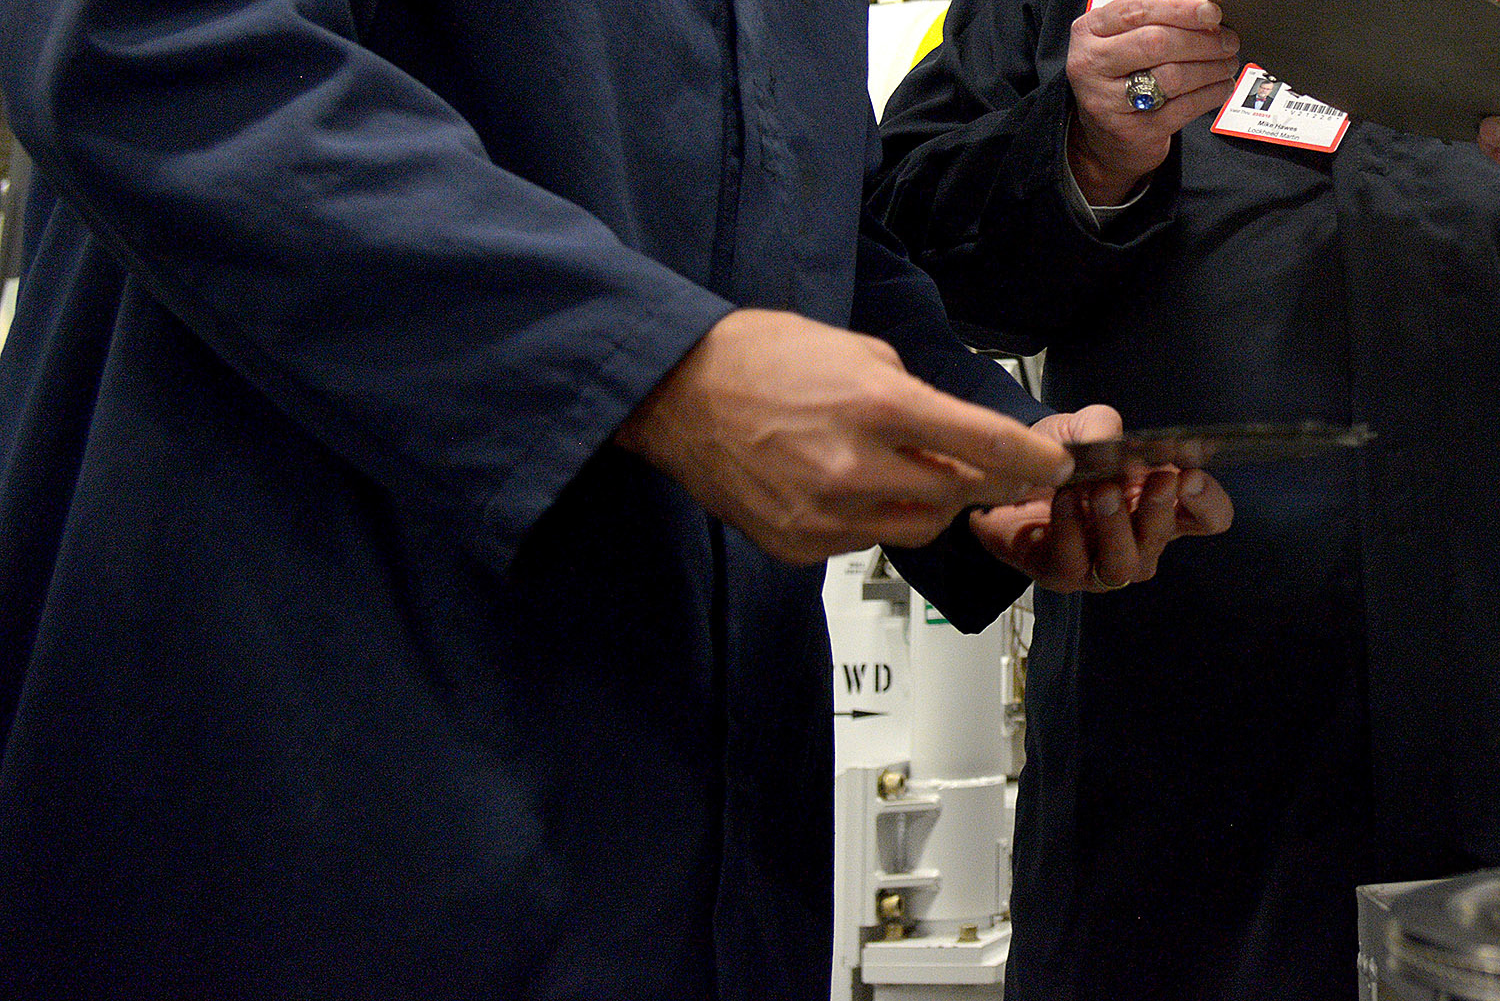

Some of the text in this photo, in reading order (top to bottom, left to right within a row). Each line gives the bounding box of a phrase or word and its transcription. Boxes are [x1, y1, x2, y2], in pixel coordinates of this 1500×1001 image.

[1257, 120, 1298, 132] Mike Hawes
[1247, 126, 1300, 141] Lockheed Martin
